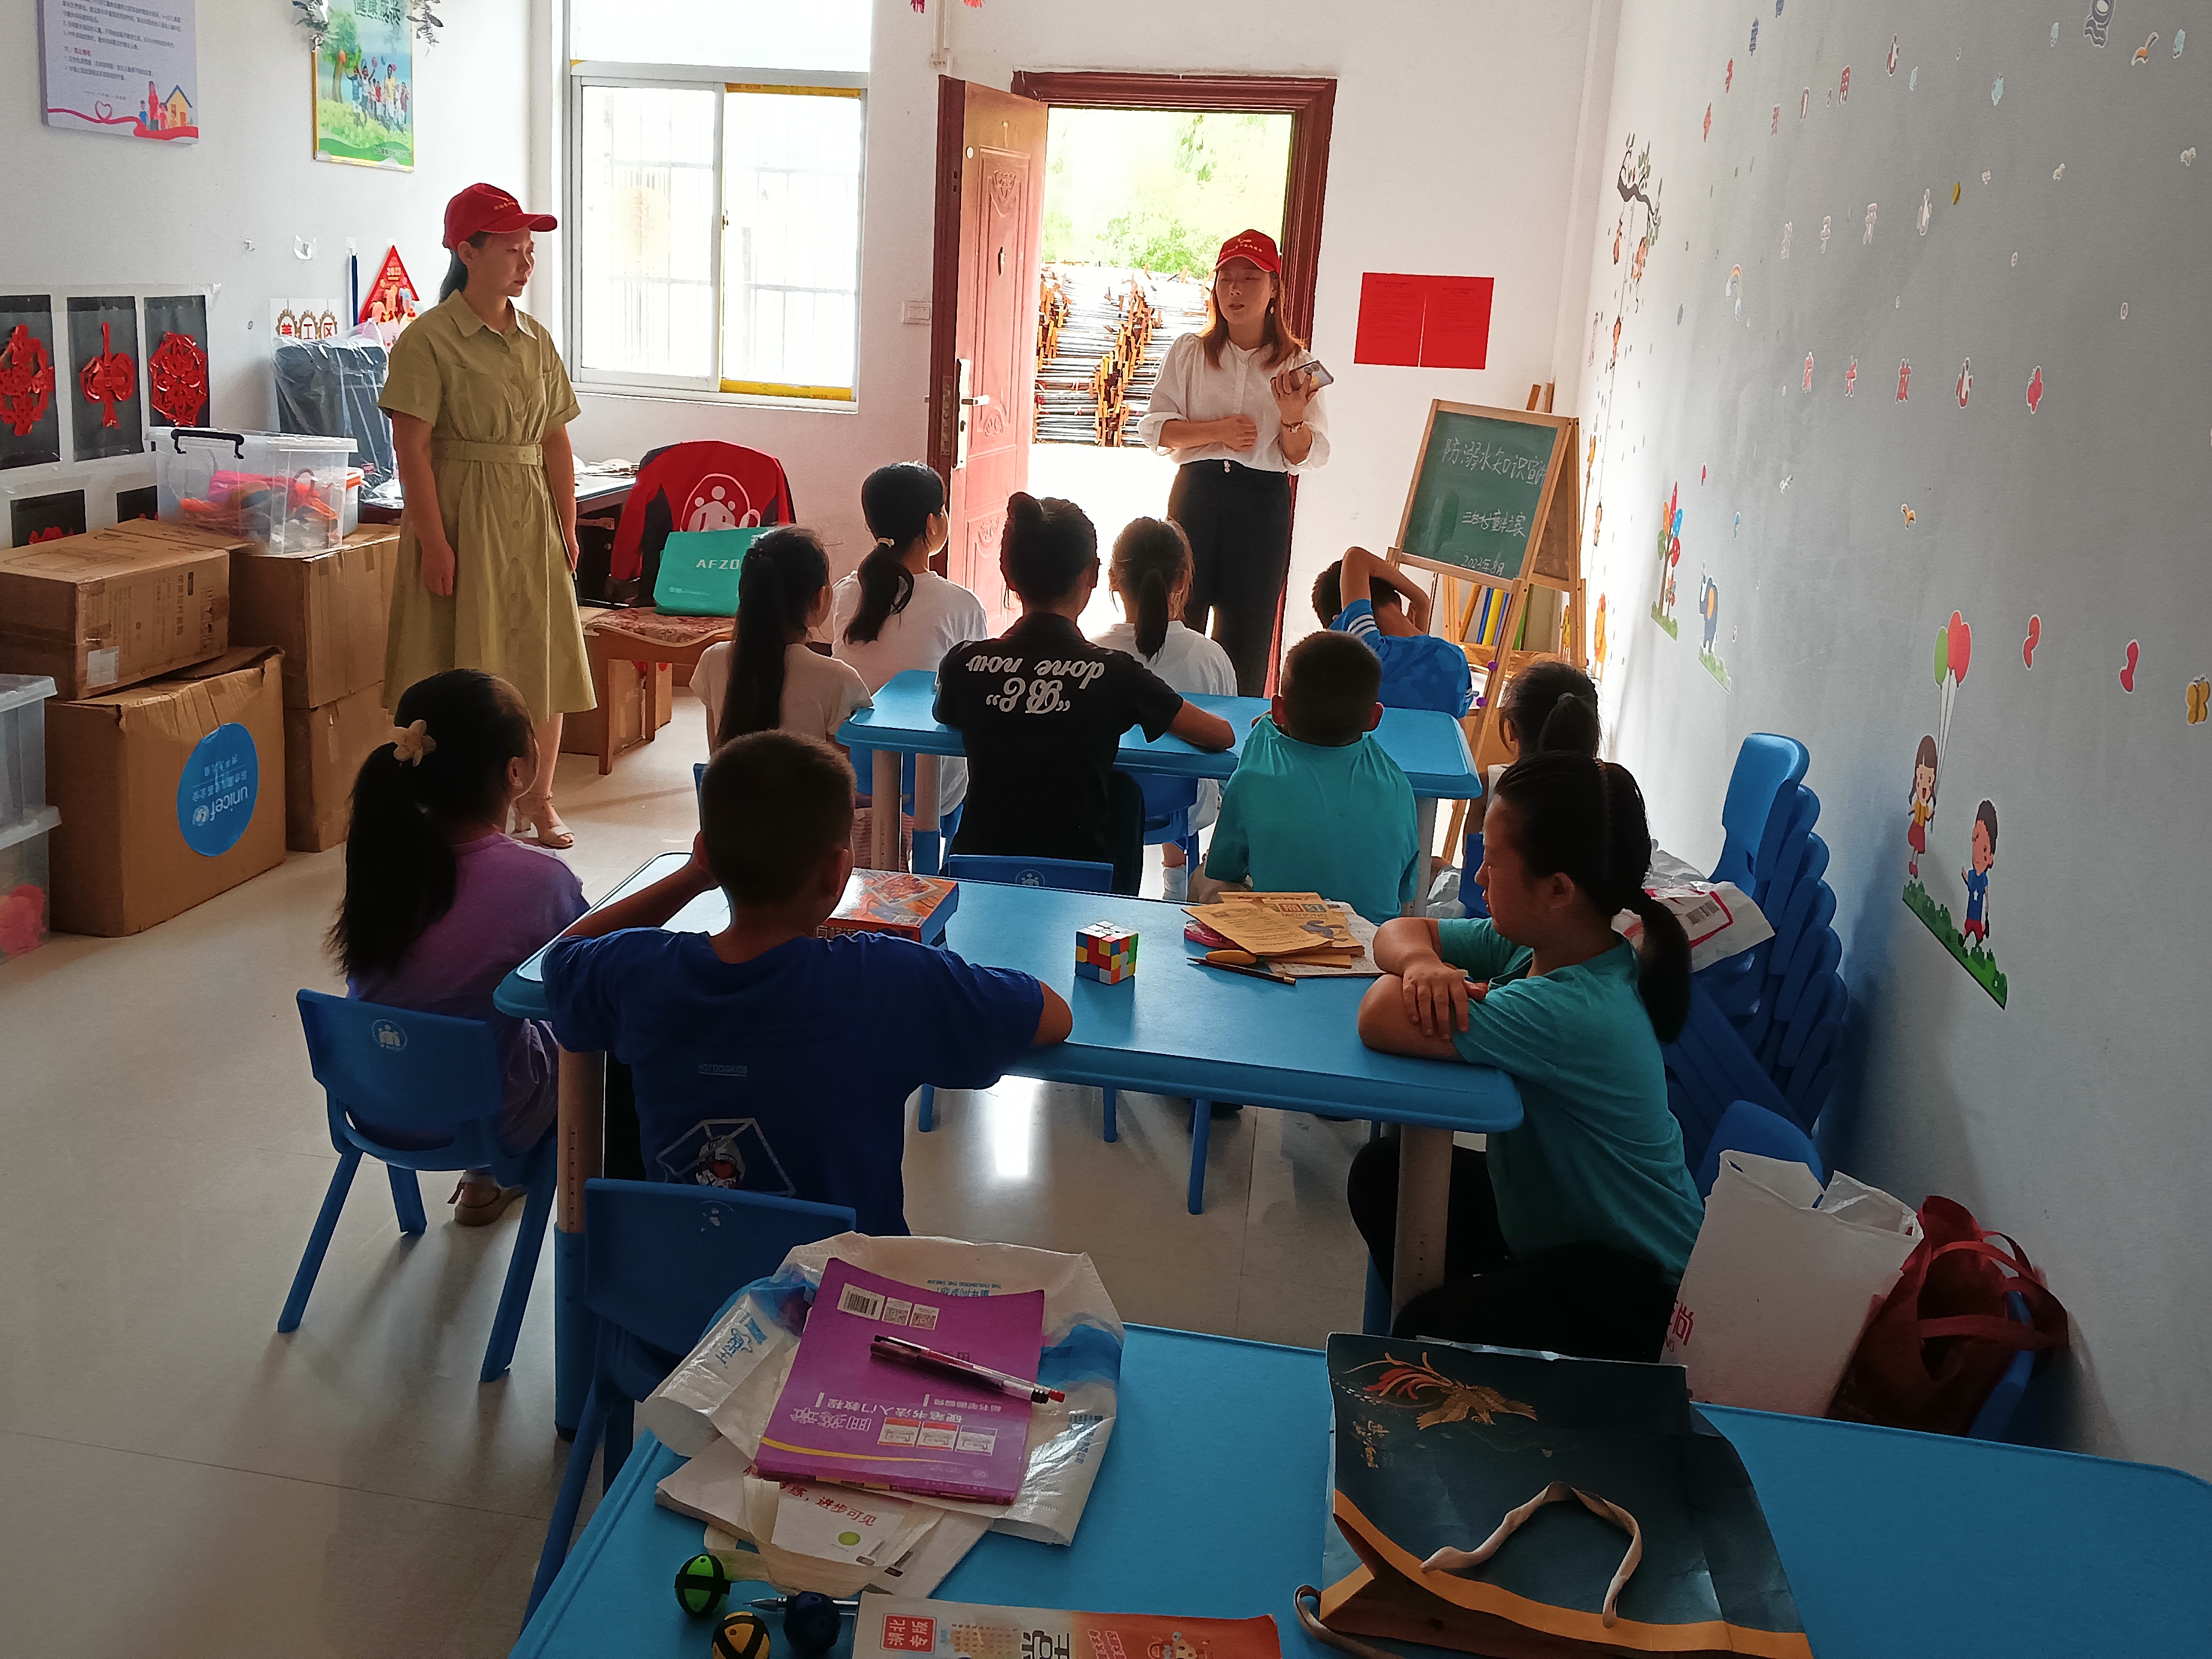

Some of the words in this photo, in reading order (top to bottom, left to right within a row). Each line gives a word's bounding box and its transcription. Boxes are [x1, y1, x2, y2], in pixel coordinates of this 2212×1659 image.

[1460, 555, 1505, 576] 2023年8月
[965, 655, 1023, 673] now
[1034, 660, 1105, 689] done
[210, 786, 248, 821] unicef
[789, 1407, 873, 1433] 田英章
[826, 1397, 963, 1424] 硬笔书法入门教程
[887, 1619, 905, 1646] 湖北
[909, 1621, 928, 1648] 专版
